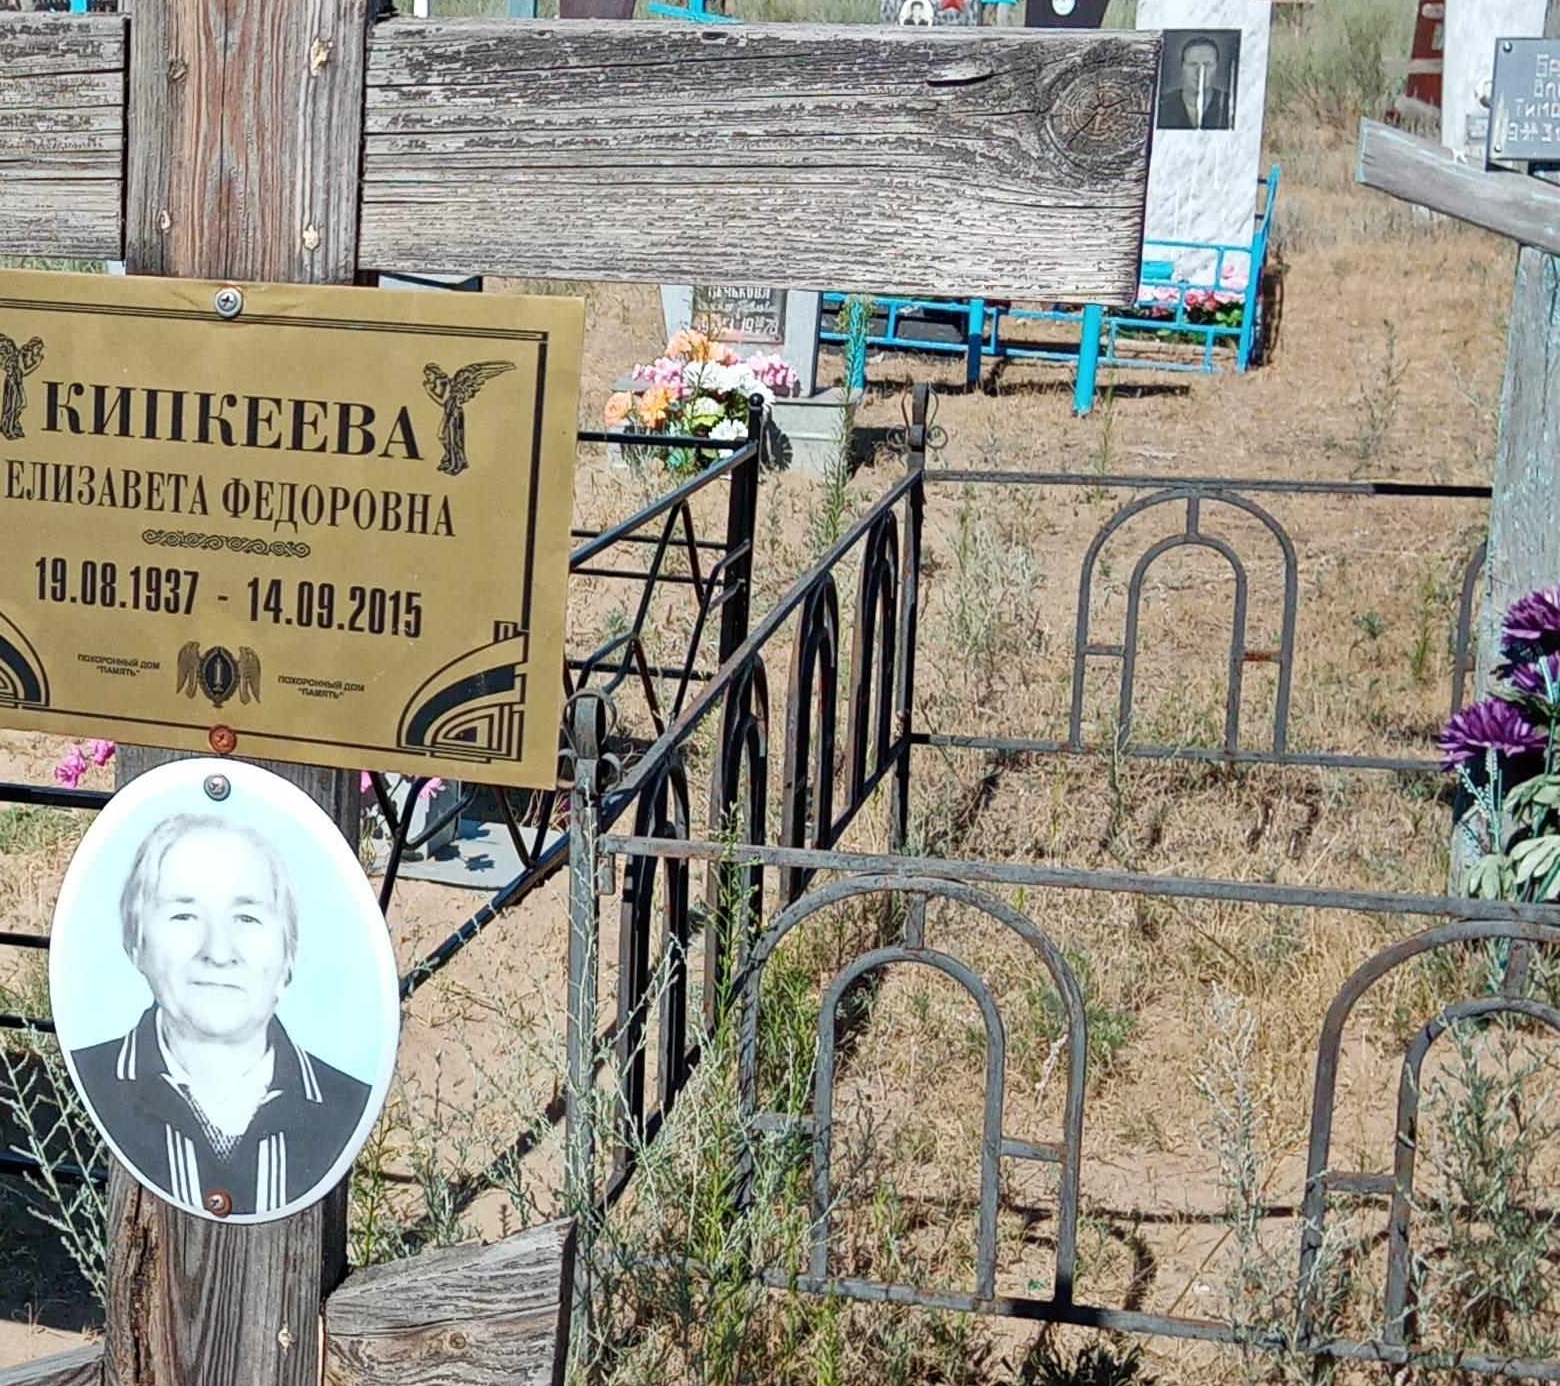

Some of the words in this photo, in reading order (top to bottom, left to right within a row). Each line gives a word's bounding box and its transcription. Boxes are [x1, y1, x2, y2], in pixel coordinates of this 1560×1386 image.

[42, 380, 424, 460] КИПКЕЕВА
[4, 458, 210, 517] ЕЛИЗАВЕТА
[222, 477, 456, 538] ФЕДОРОВНА
[34, 557, 200, 616] 19.08.1937
[247, 576, 423, 639] 14.09.2015
[77, 653, 139, 669] ПОХОРОННЫЙ
[140, 660, 161, 671] ДОМ
[96, 665, 141, 678] "ПАМЯТЬ"
[277, 674, 342, 691] ПОХОРОННЫЙ
[343, 682, 366, 693] ДОМ
[297, 686, 345, 700] "ПАМЯТЬ"
